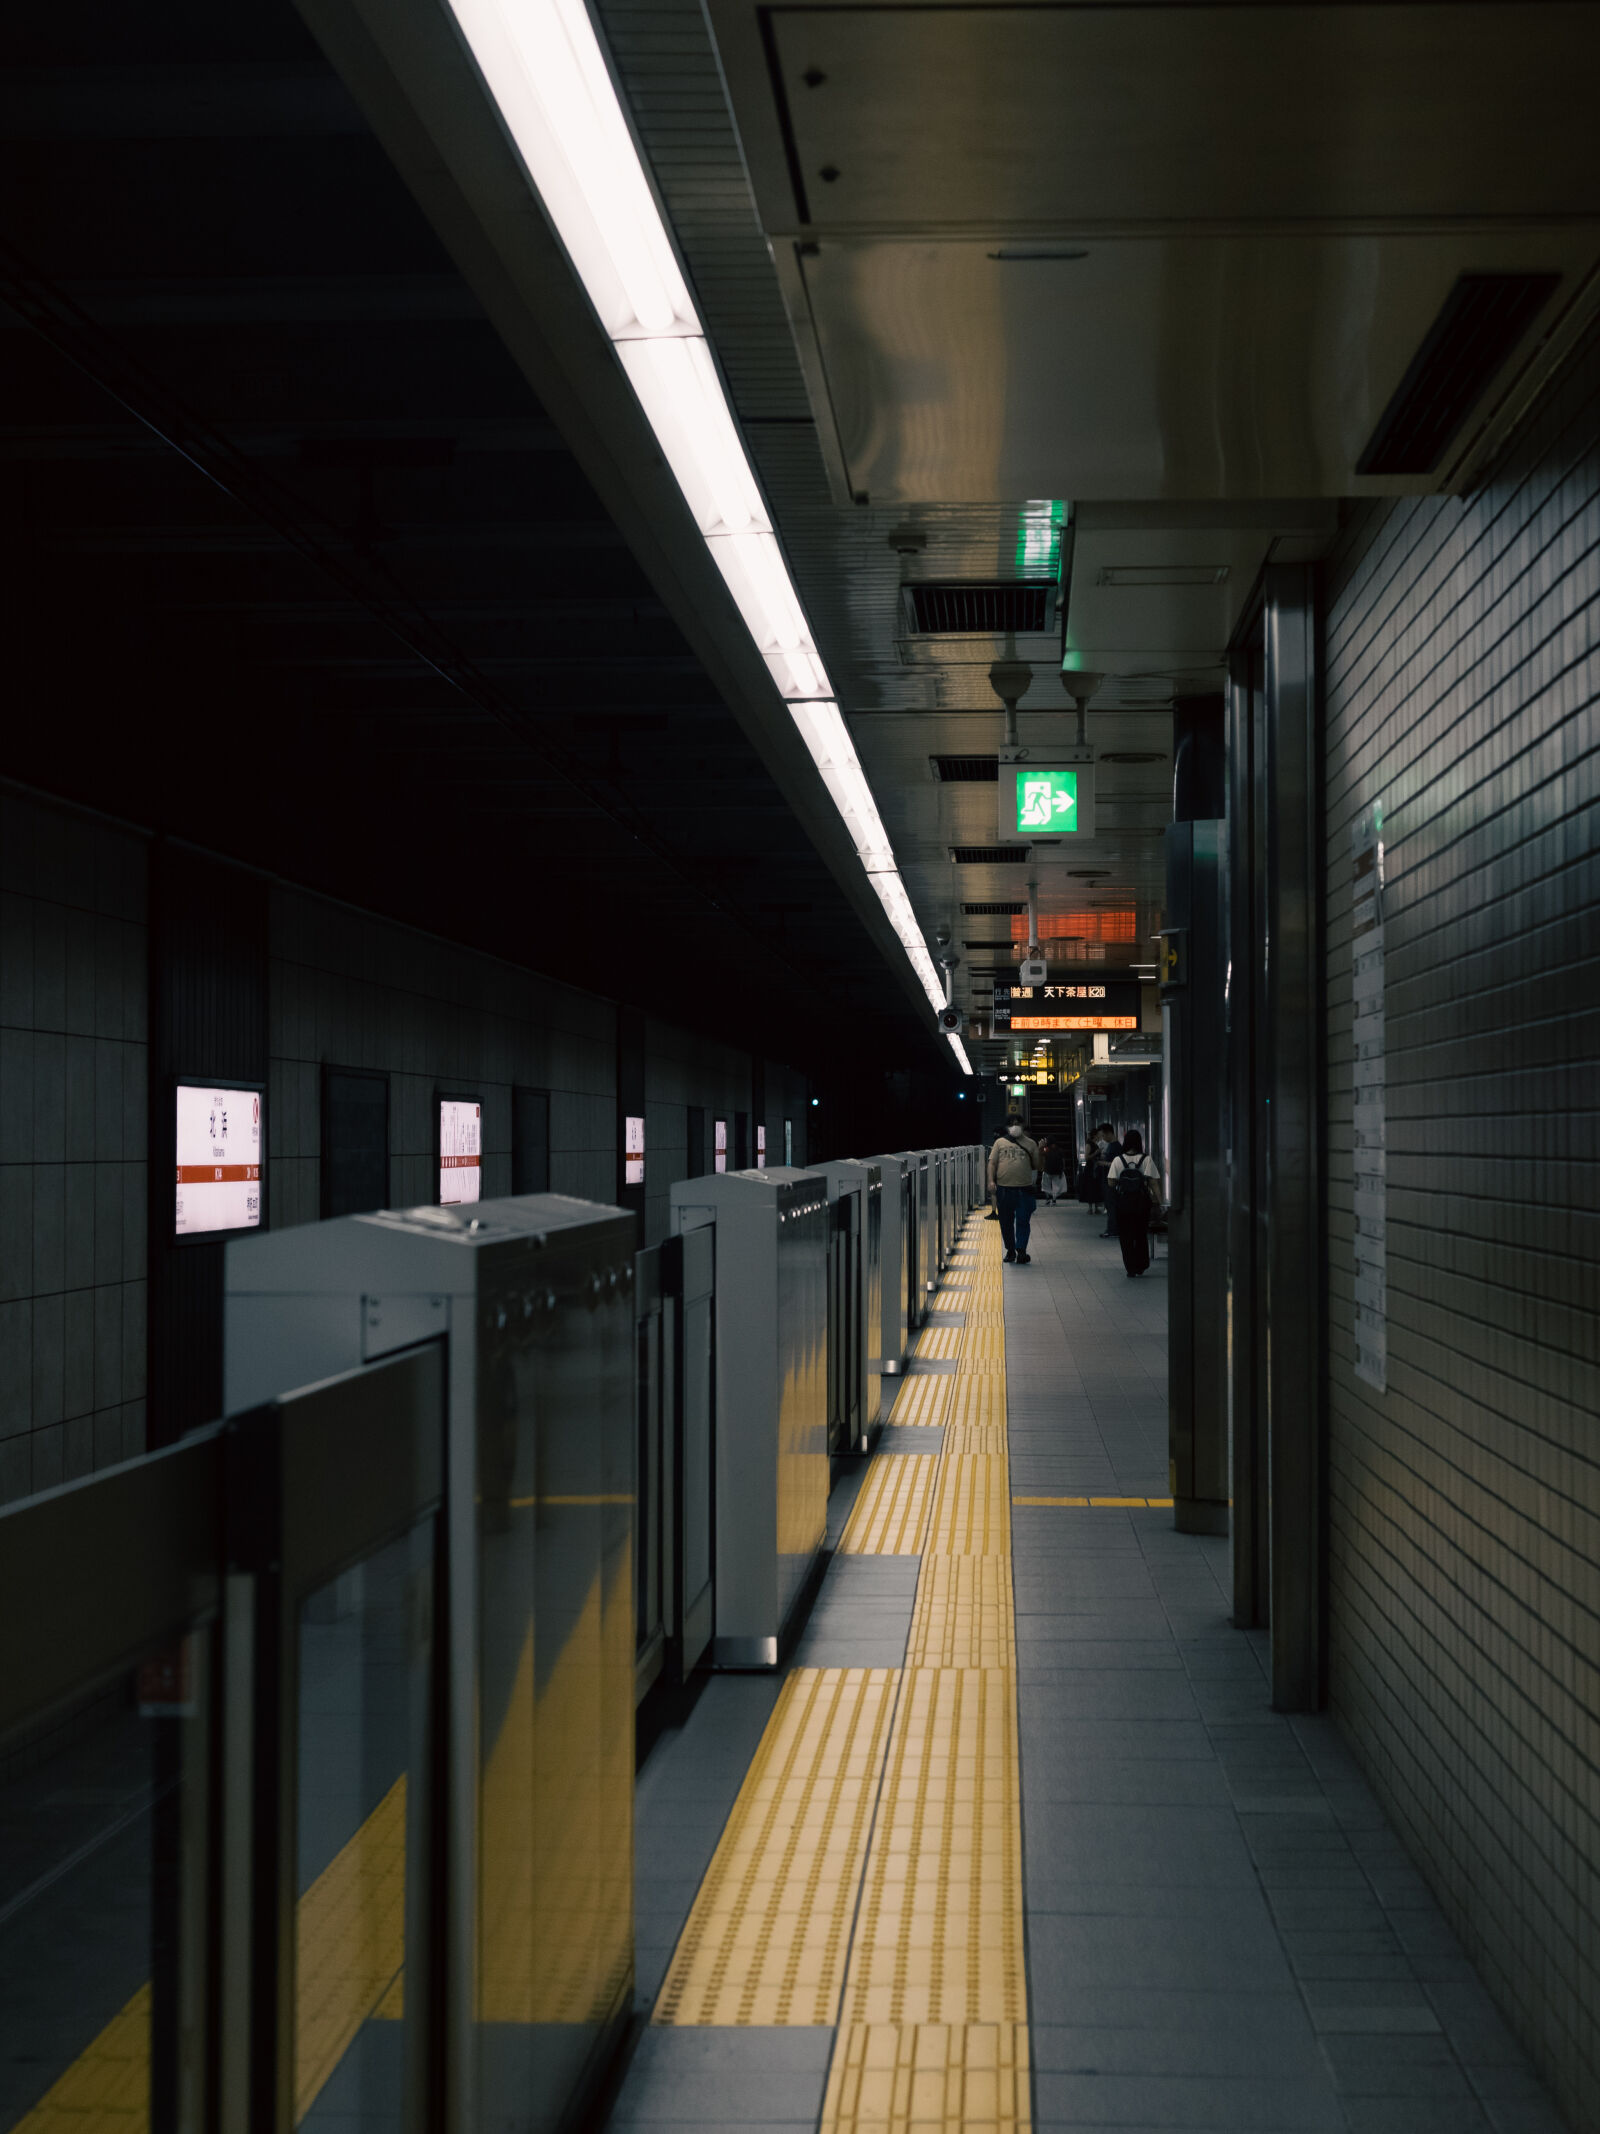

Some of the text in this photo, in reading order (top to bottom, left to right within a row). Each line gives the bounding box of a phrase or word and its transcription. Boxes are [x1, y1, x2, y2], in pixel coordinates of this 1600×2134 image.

[1044, 986, 1087, 998] 天下茶屋
[1088, 986, 1105, 998] K20
[975, 1022, 982, 1036] 1
